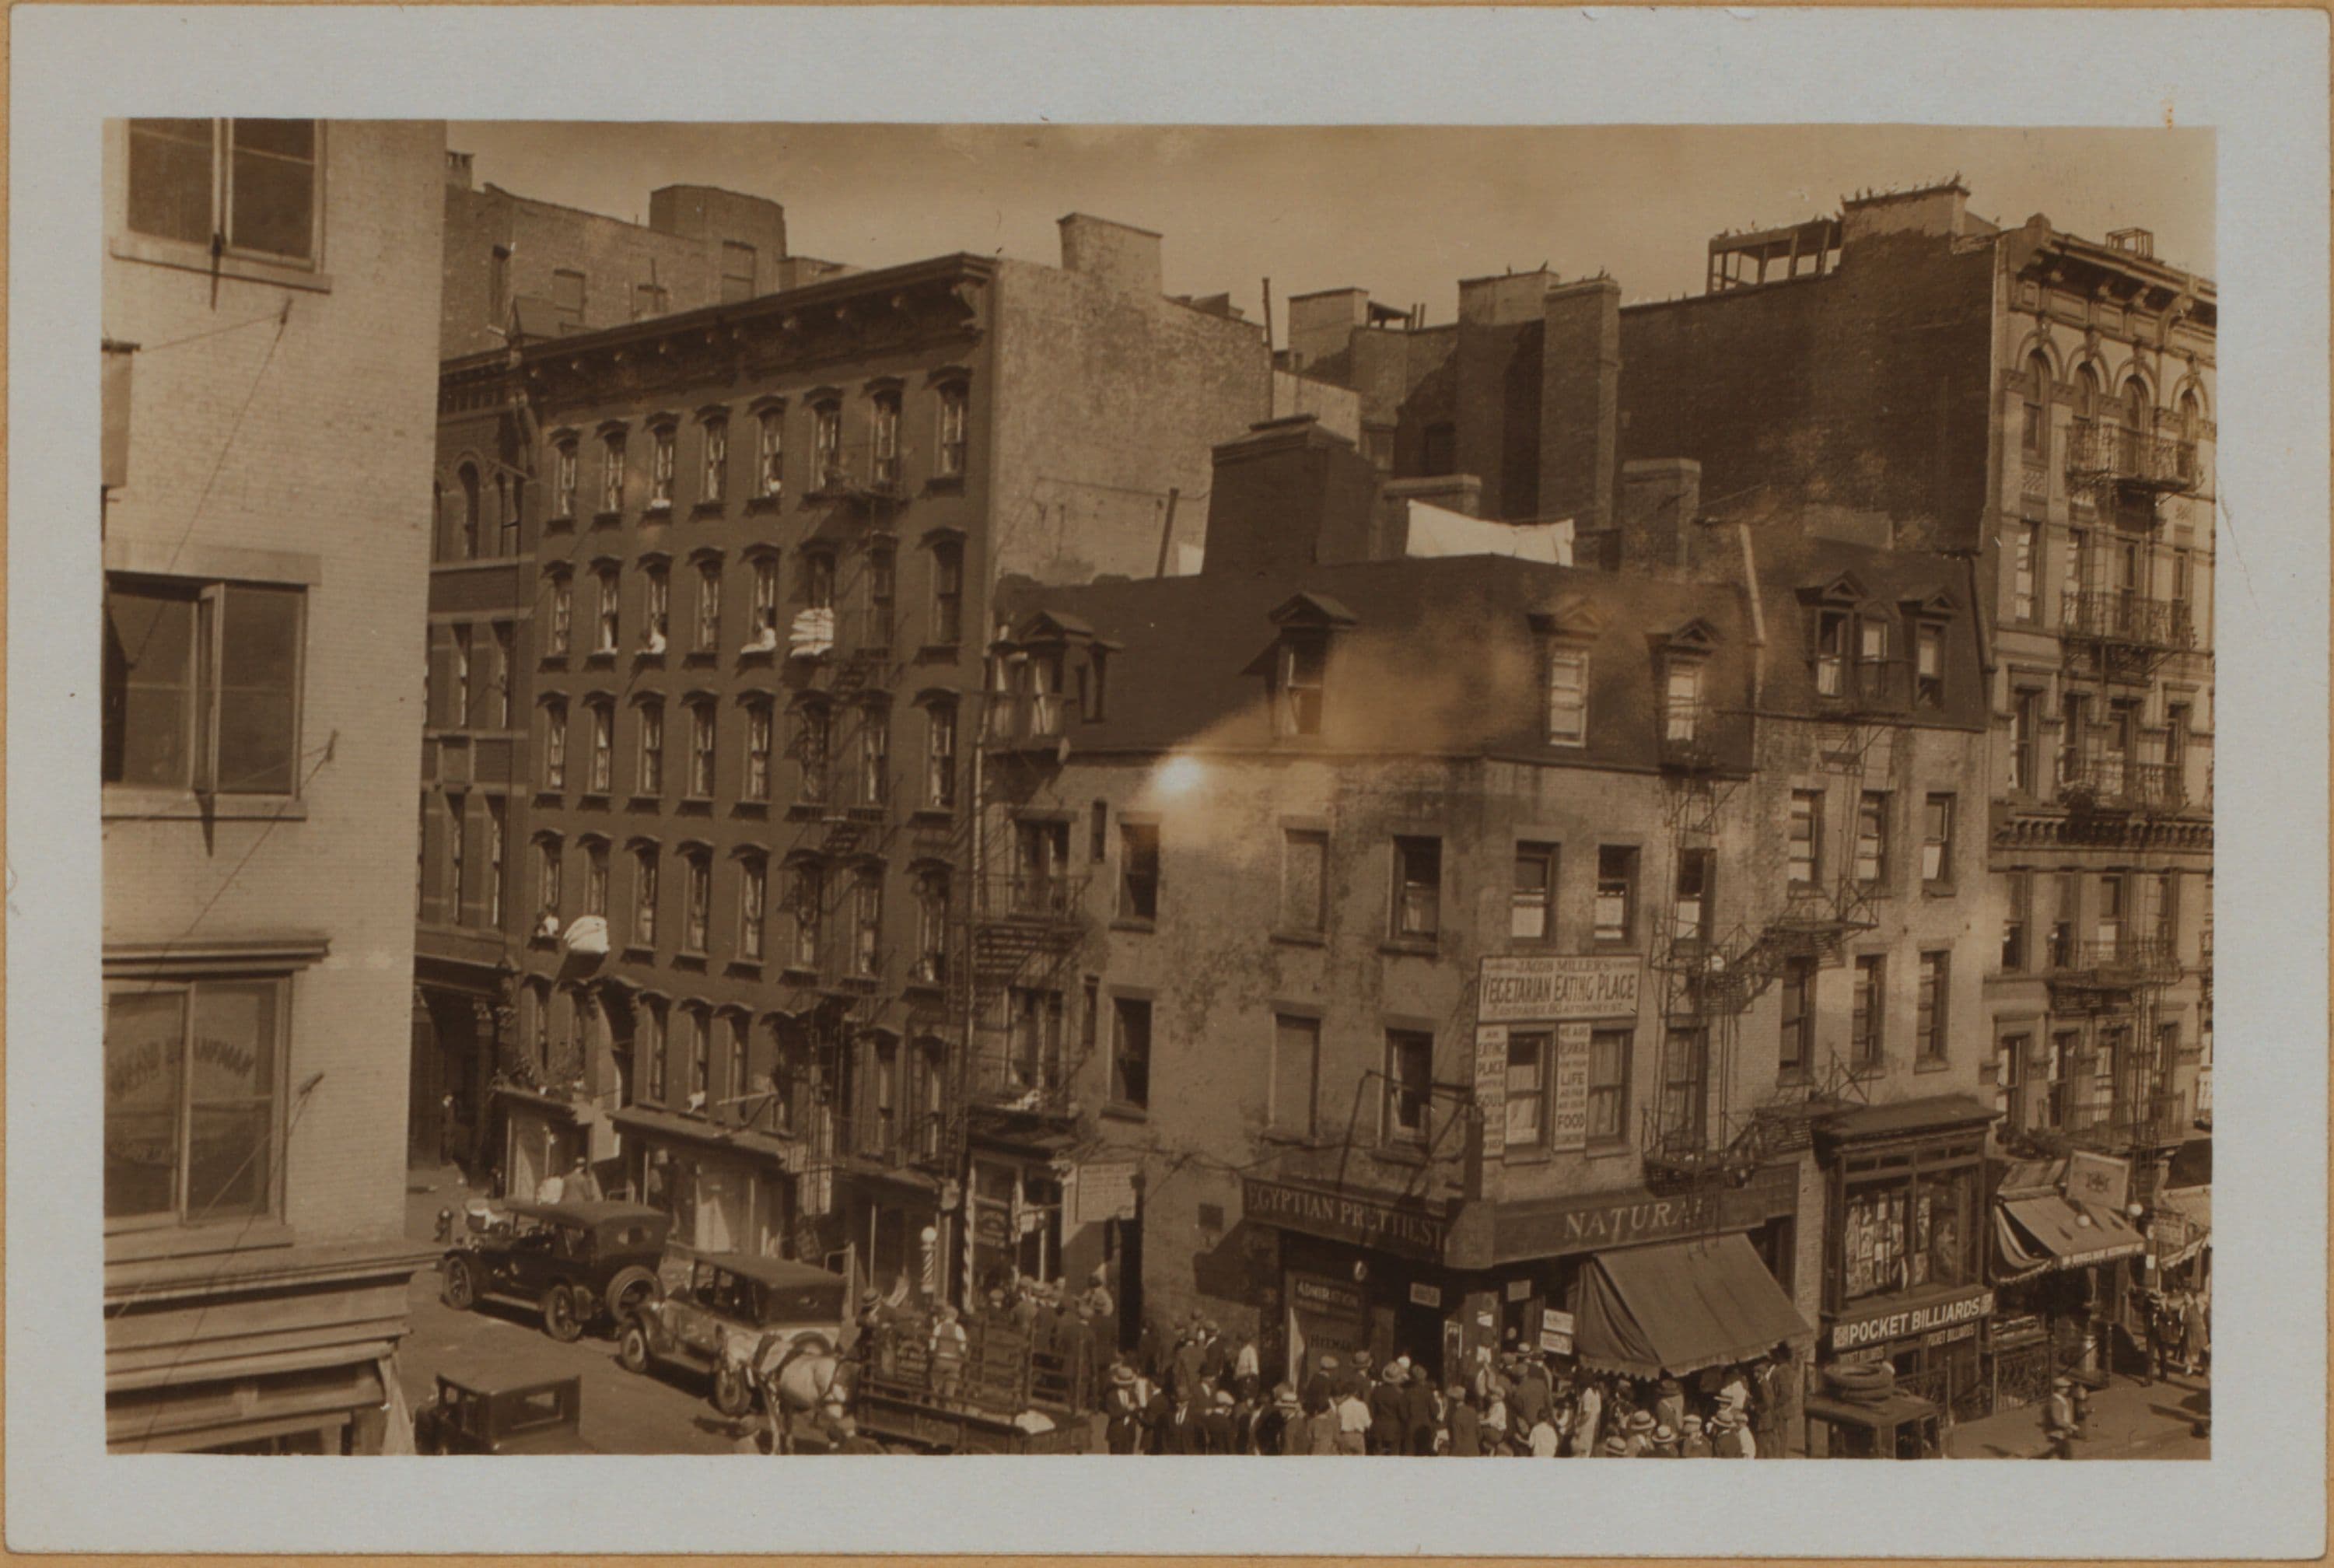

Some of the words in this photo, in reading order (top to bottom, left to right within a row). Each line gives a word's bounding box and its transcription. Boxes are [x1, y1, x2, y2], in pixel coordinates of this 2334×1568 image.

[1482, 973, 1552, 1004] VEGETARIAN
[1555, 973, 1594, 1002] EATING
[1597, 972, 1635, 1000] PLACE
[1477, 1060, 1504, 1077] PLACE
[1561, 1072, 1585, 1087] LIFE
[1557, 1112, 1585, 1129] FOOD
[1245, 1181, 1335, 1220] EGYPTIAN
[1849, 1311, 1909, 1346] POCKET
[1911, 1297, 1981, 1331] BILLIARDS
